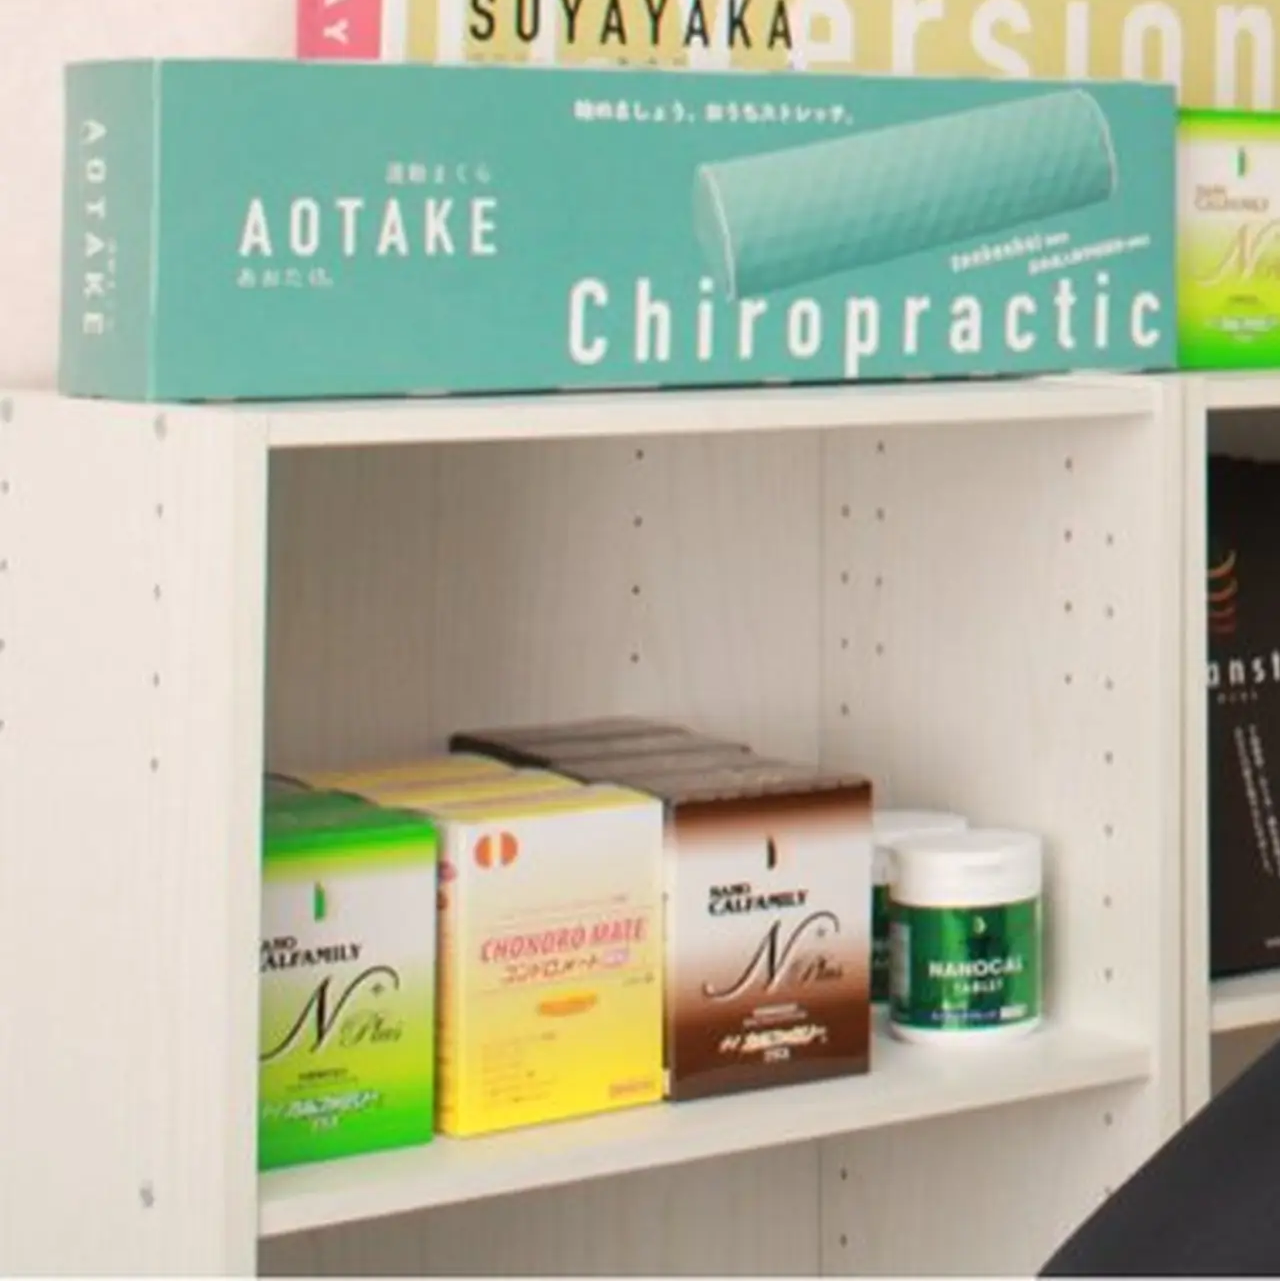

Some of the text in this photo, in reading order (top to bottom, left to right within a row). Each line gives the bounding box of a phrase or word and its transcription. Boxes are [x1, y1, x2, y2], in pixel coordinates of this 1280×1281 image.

[80, 119, 108, 335] AOTAKE
[239, 196, 498, 258] AOTAKE
[568, 271, 1161, 376] Chiropractic
[260, 943, 361, 972] ALFAMILY
